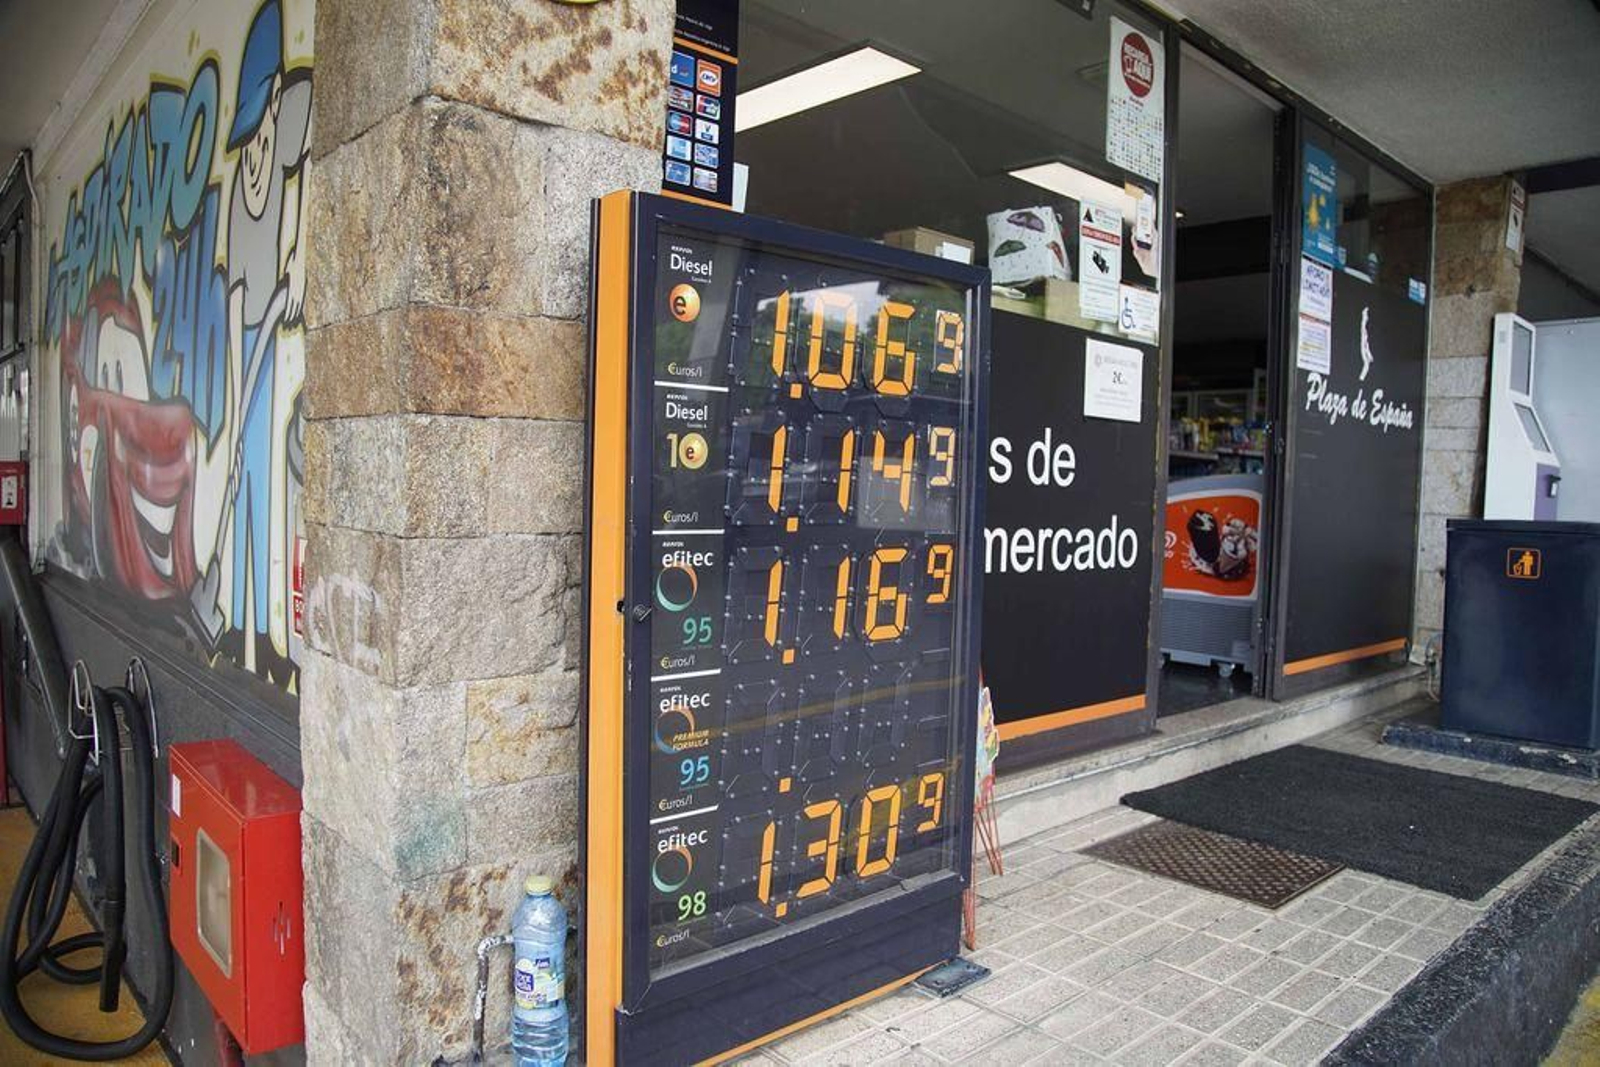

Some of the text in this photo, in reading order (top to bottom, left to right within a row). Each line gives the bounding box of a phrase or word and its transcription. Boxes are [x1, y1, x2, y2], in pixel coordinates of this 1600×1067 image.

[670, 253, 713, 277] Diesel
[665, 402, 708, 421] Diesel
[1305, 372, 1413, 434] Plaza de España
[1027, 427, 1076, 487] de
[662, 551, 714, 568] efitec
[683, 616, 712, 644] 95
[660, 692, 711, 713] efitec
[680, 755, 710, 785] 95
[657, 829, 708, 853] efitec
[678, 890, 707, 921] 98
